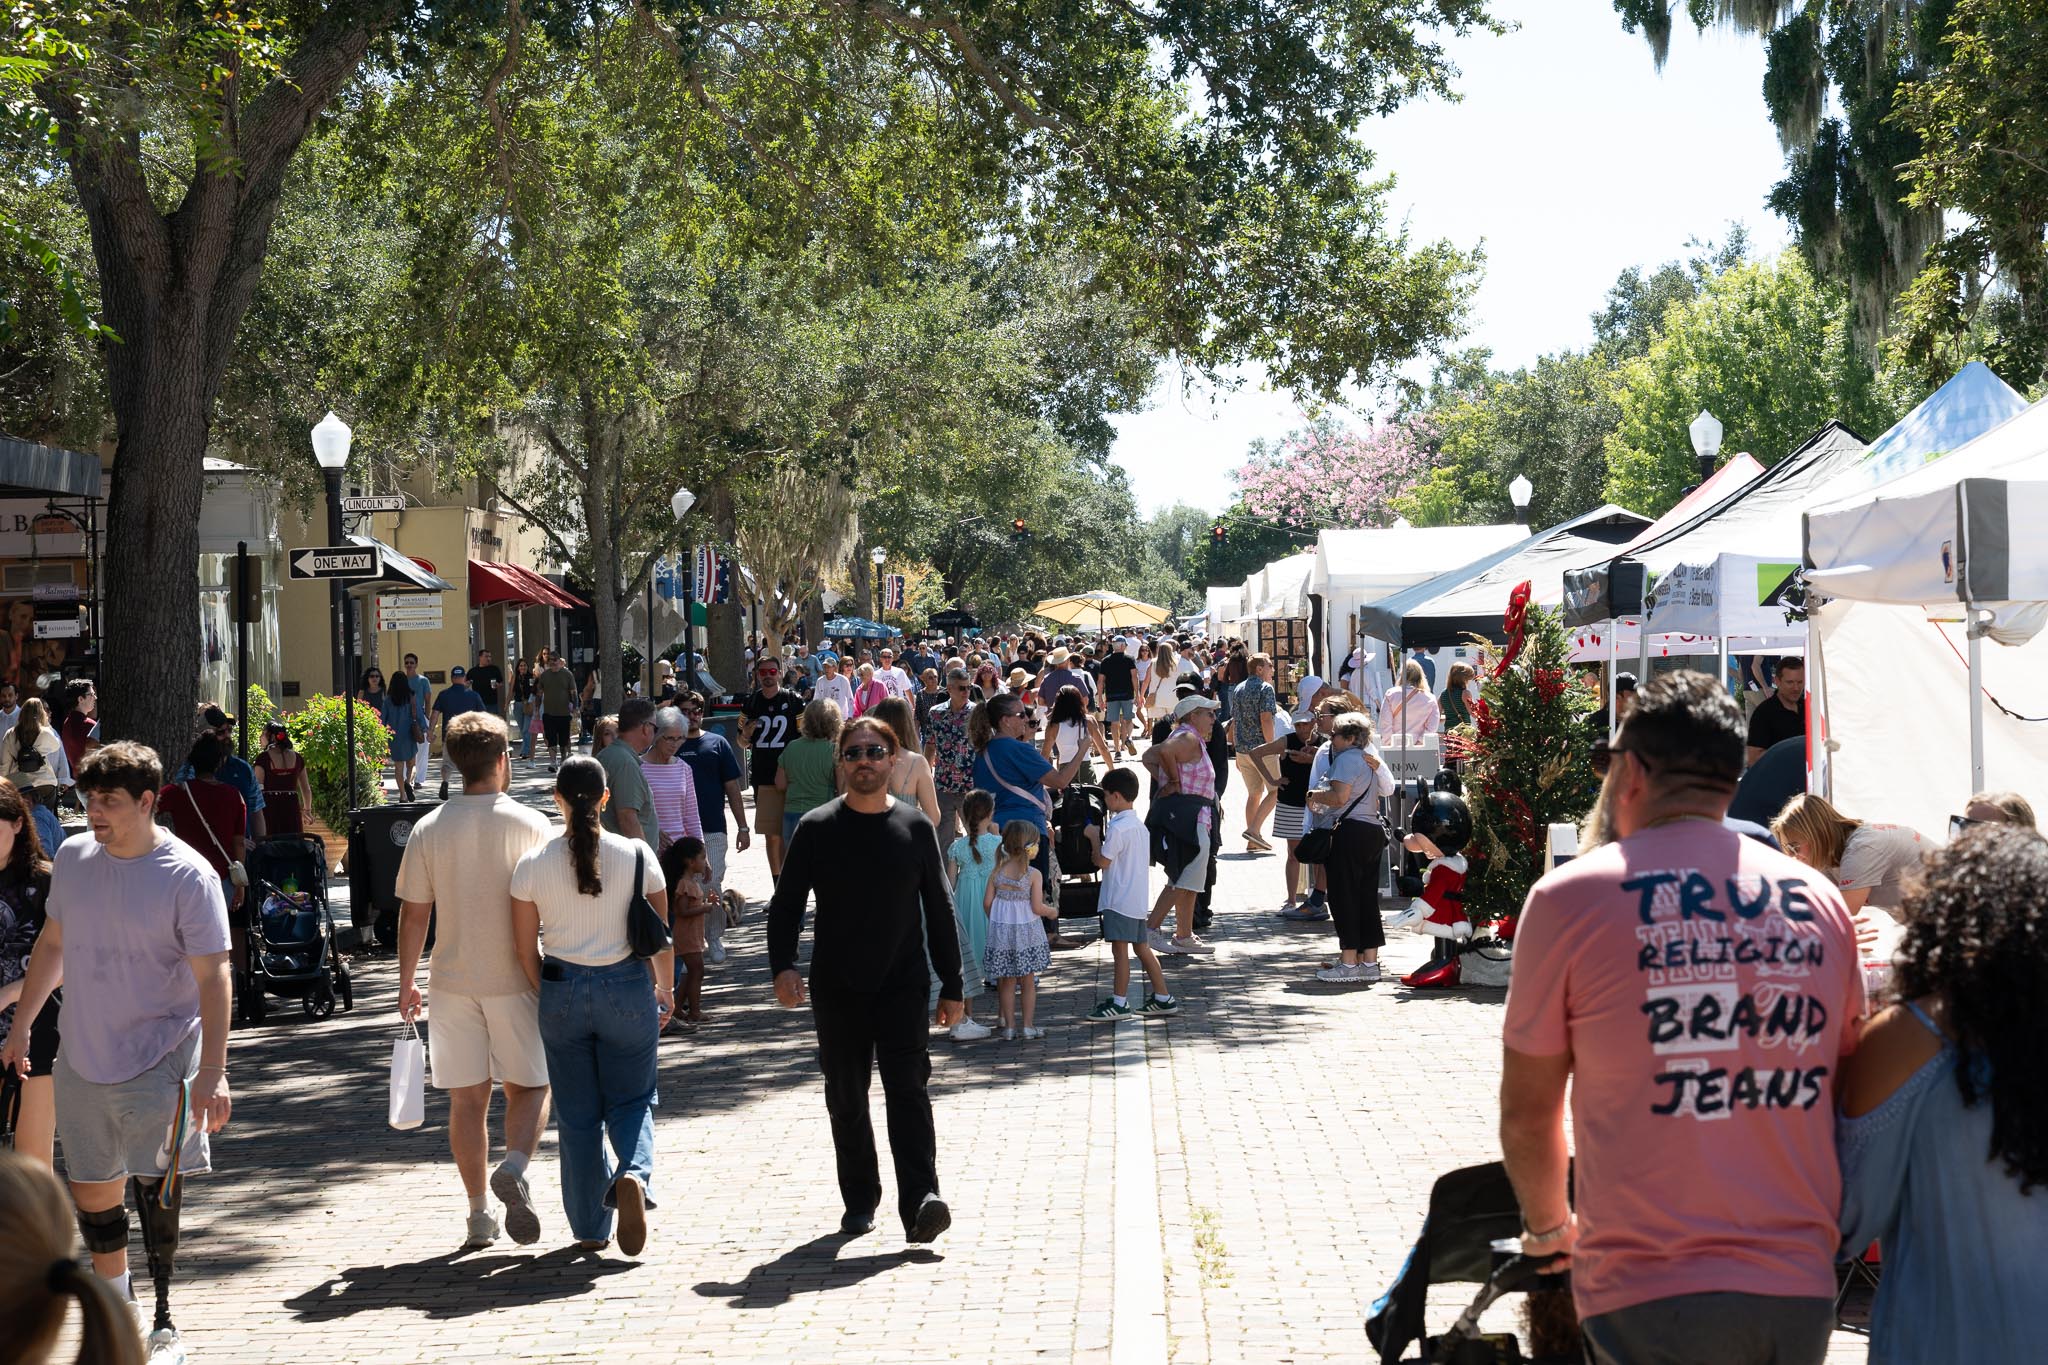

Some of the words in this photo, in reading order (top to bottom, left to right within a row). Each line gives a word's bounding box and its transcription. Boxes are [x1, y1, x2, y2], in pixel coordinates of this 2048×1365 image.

[348, 499, 383, 510] LINCOLN
[314, 556, 338, 569] ONE
[341, 555, 367, 568] WAY
[698, 548, 706, 577] WINTER
[697, 578, 705, 599] PARK
[756, 715, 788, 748] 22
[1621, 872, 1814, 925] TRUE
[1638, 937, 1824, 972] RELIGION
[1641, 994, 1827, 1043] BRAND
[1651, 1066, 1828, 1115] JEANS
